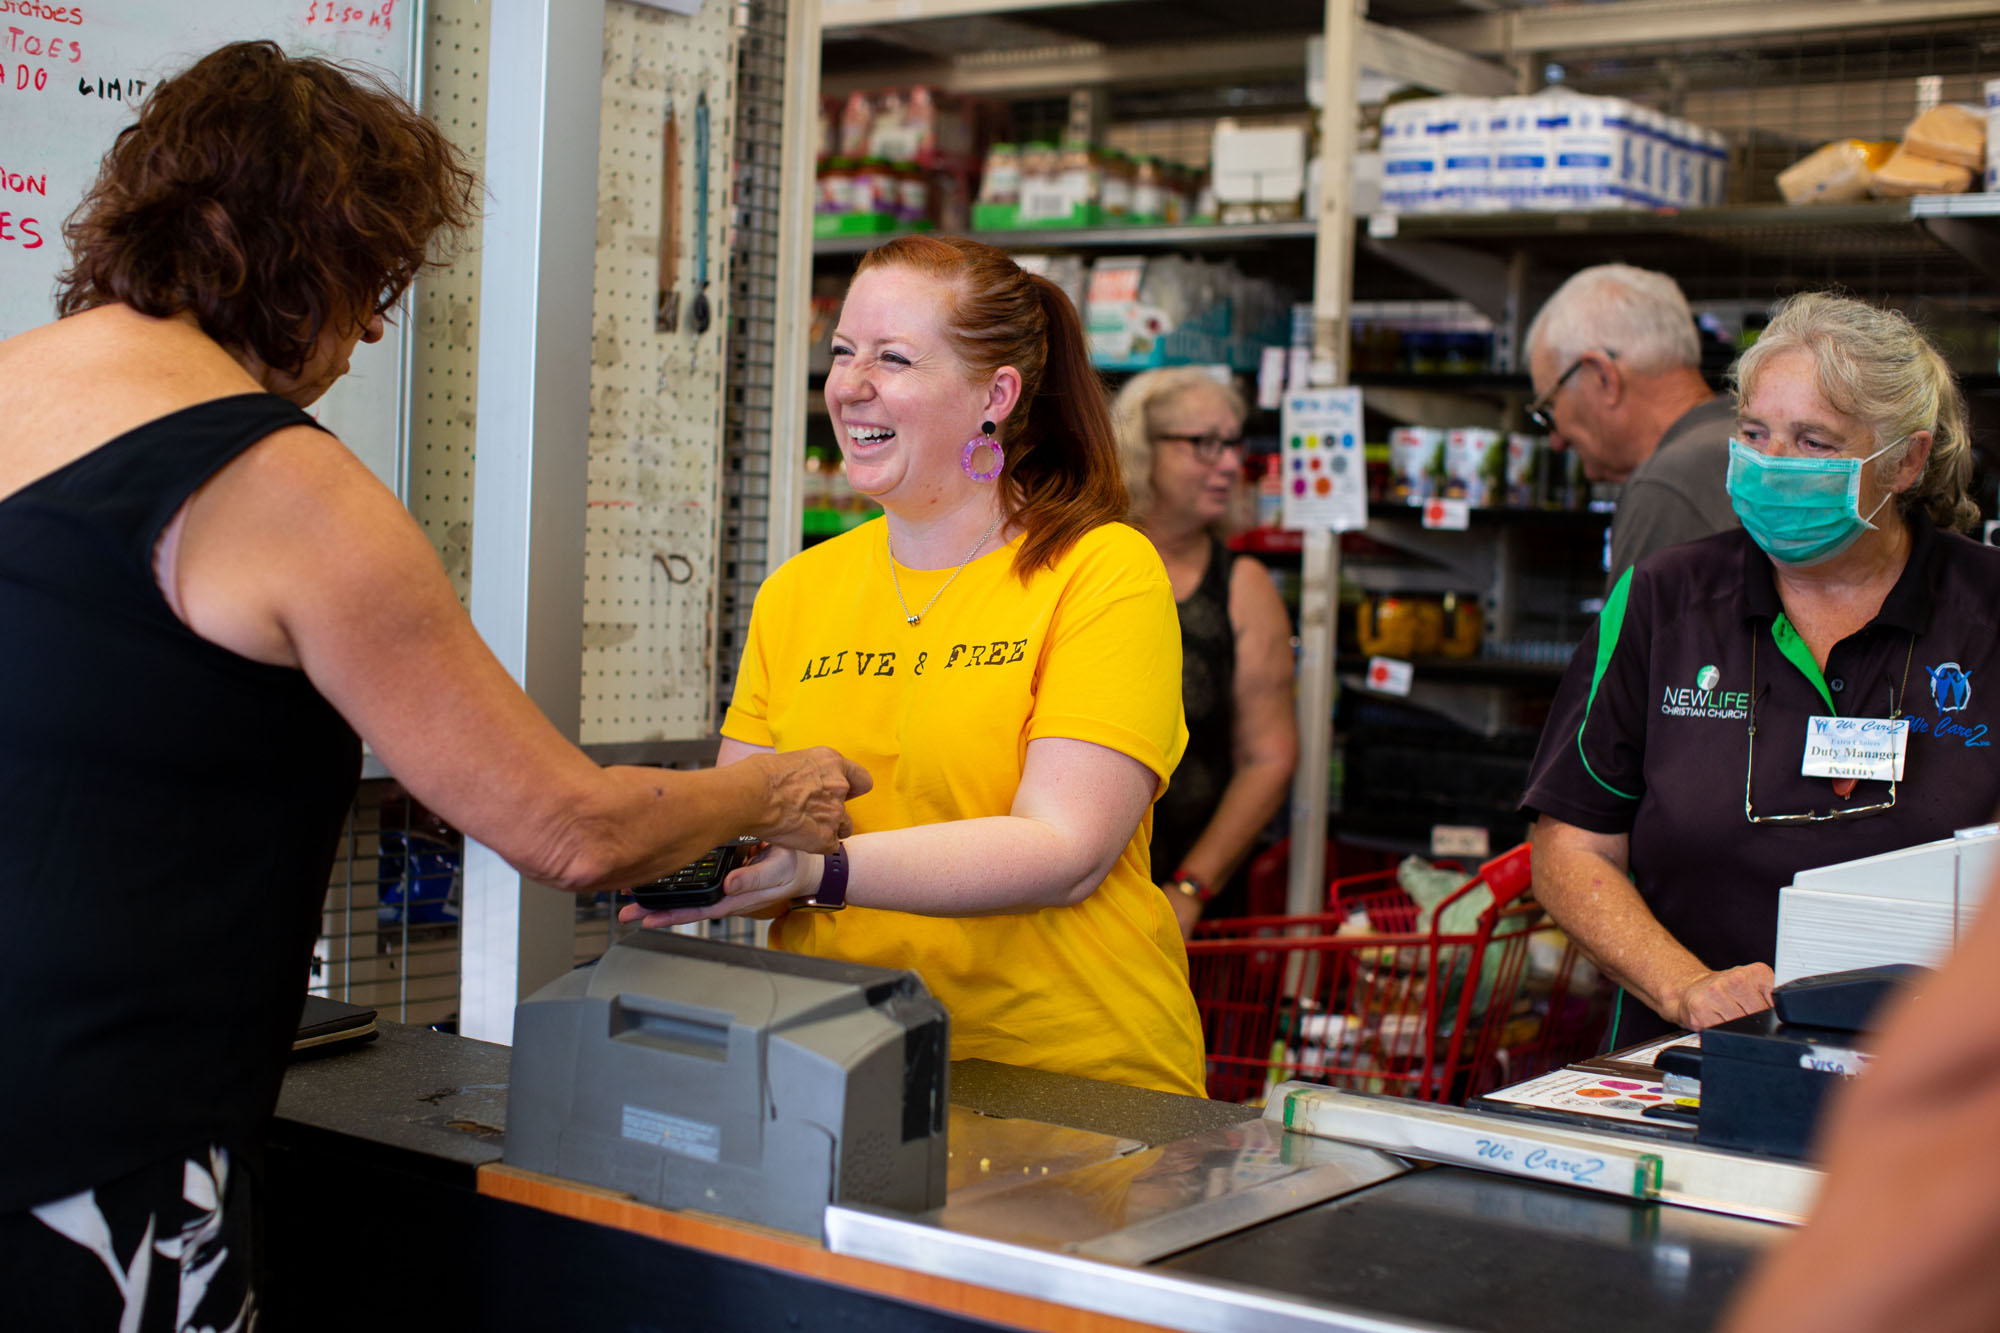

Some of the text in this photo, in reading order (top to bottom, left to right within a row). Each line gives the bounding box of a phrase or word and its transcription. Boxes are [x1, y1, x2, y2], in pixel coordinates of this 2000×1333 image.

[78, 76, 148, 101] LIMIT
[799, 638, 1028, 682] ALIVE & FREE
[1663, 685, 1749, 710] NEWLIFE
[1661, 704, 1748, 720] CHRISTIAN CHURCH
[1834, 719, 1857, 730] We
[1810, 745, 1900, 761] Duty Manager
[1475, 1139, 1605, 1183] We Care2
